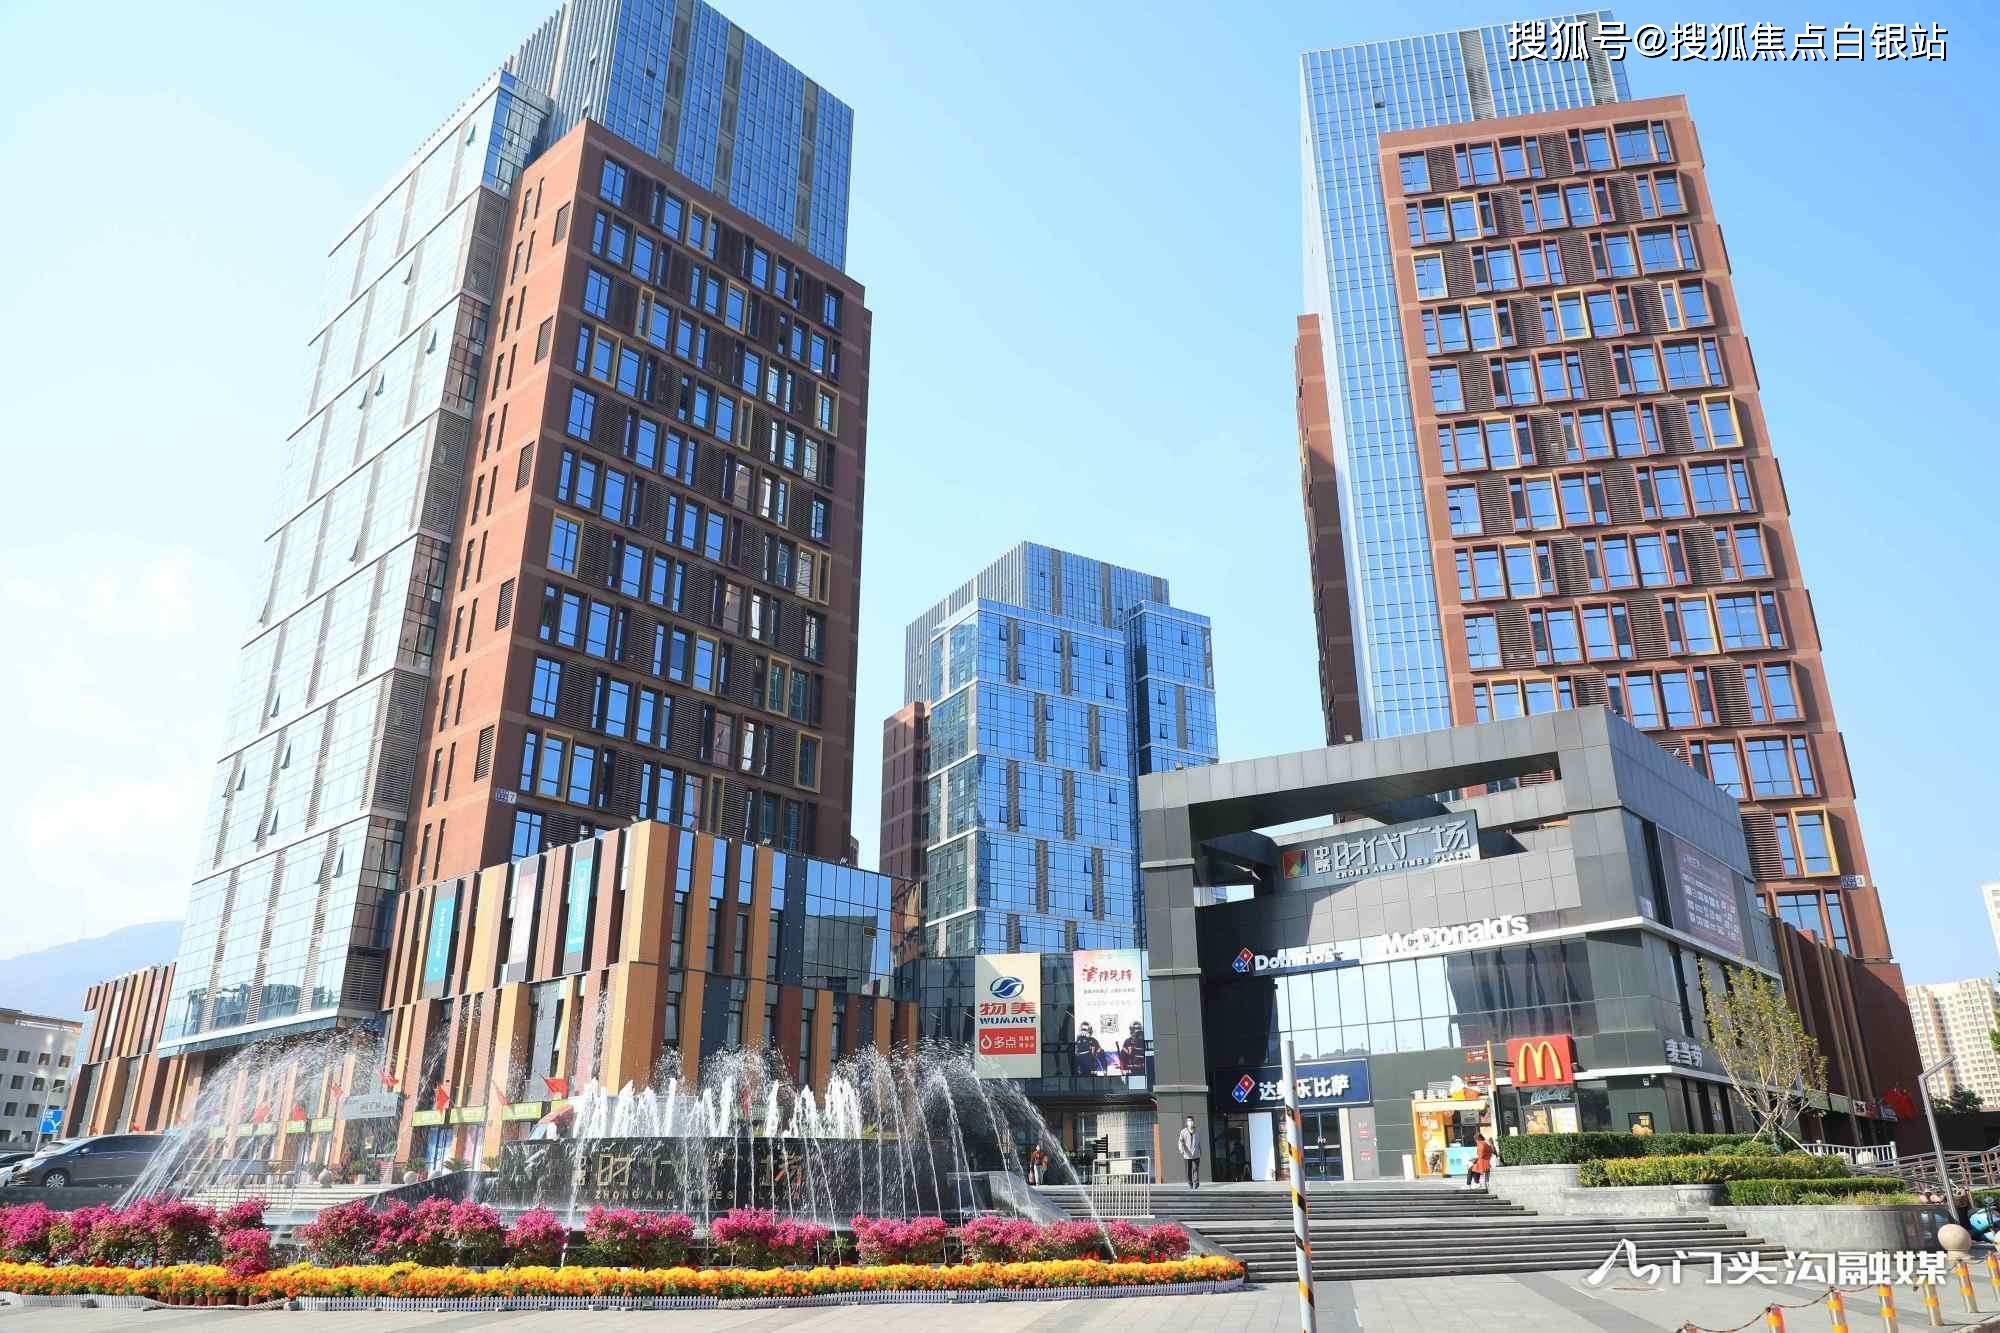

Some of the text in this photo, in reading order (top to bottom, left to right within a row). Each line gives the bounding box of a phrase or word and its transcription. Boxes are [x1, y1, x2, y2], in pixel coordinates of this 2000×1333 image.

[979, 1001, 1037, 1016] 物美
[979, 1016, 1036, 1025] WUMART
[993, 1034, 1017, 1049] 多点
